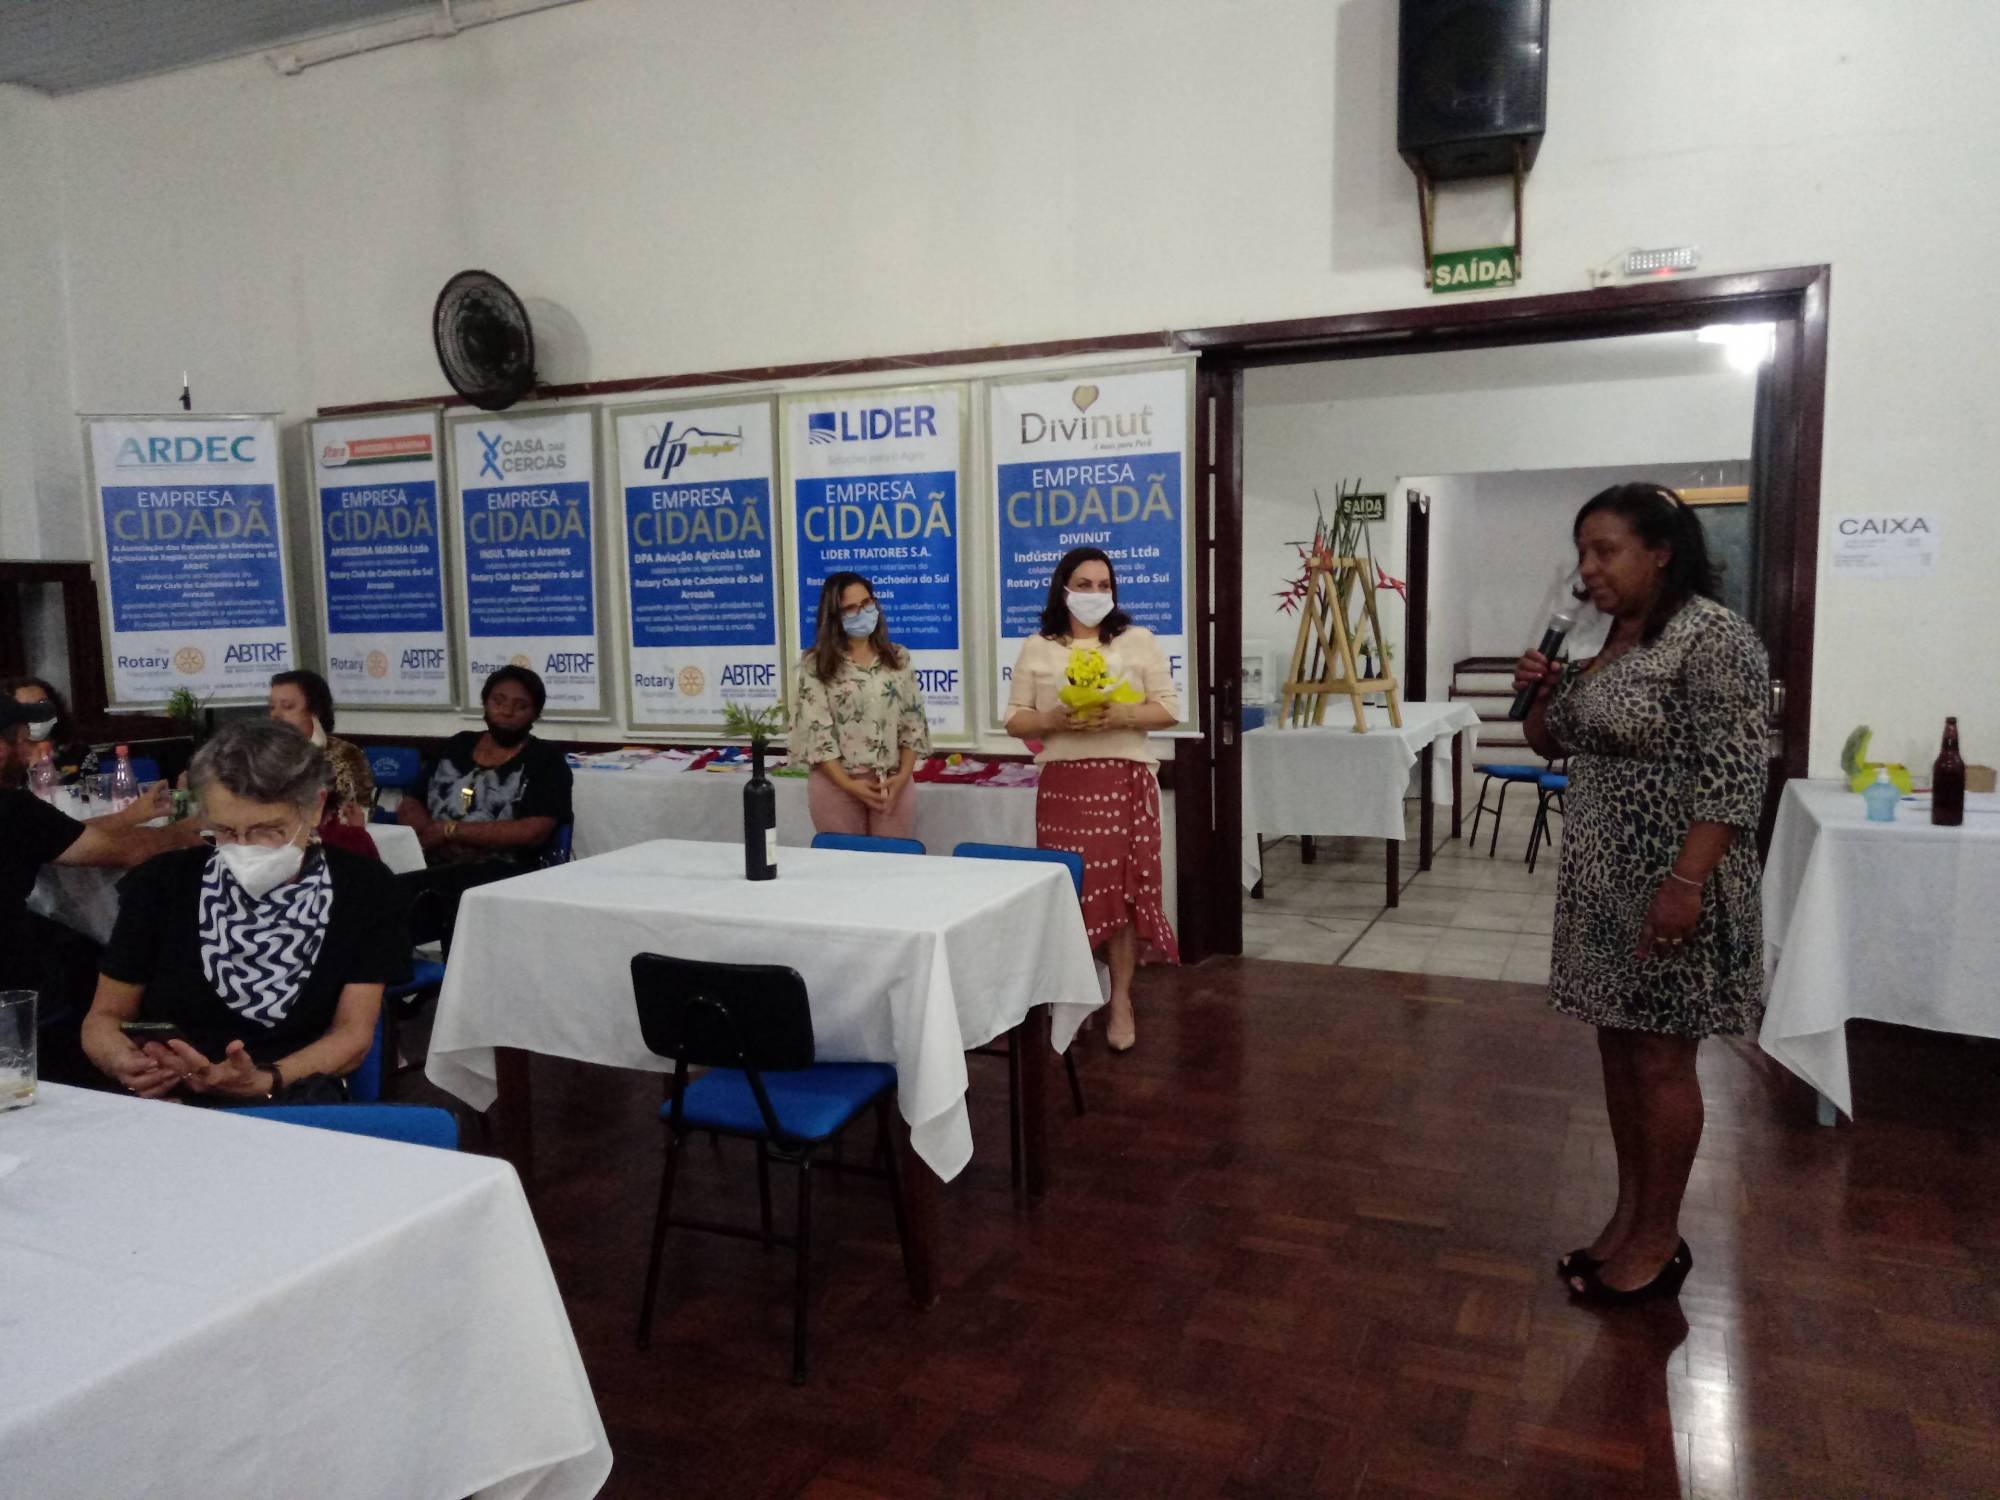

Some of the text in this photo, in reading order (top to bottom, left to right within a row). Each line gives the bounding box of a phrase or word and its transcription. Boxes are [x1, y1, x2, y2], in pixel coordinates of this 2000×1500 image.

[1435, 259, 1513, 287] SAÍDA
[841, 404, 938, 442] LIDER
[1020, 404, 1154, 445] Divinut
[115, 435, 256, 464] ARDEC
[501, 438, 545, 456] CASA
[644, 421, 688, 480] dp
[502, 454, 567, 473] CERCAS
[1032, 463, 1135, 488] EMPRESA
[137, 490, 235, 508] EMPRESA
[342, 488, 408, 508] EMPRESA
[488, 490, 560, 510] EMPRESA
[652, 488, 734, 510] EMPRESA
[826, 481, 917, 503] EMPRESA
[1006, 473, 1173, 529] CIDADÃ
[1343, 497, 1383, 514] SAÍDA
[113, 500, 271, 541] CIDADÃ
[327, 498, 433, 541] CIDADÃ
[469, 499, 586, 544] CIDADÃ
[633, 497, 765, 547] CIDADÃ
[804, 491, 951, 543] CIDADÃ
[1839, 518, 1931, 535] CAIXA
[1059, 532, 1111, 545] DIVINUT
[634, 552, 653, 564] DPA
[655, 551, 693, 565] Aviação
[737, 548, 761, 559] Ltda
[820, 546, 931, 560] LIDER TRATORES S.A.
[1015, 550, 1064, 563] Indústri
[1131, 545, 1159, 558] Ltda
[872, 575, 917, 586] Cachoeira
[920, 574, 932, 583] do
[934, 573, 949, 583] Sul
[1006, 578, 1040, 590] Rotary
[1136, 575, 1150, 584] do
[1152, 573, 1169, 583] Sul
[118, 642, 287, 670] Rotary ABTRF
[330, 648, 444, 673] Rotary ABTRF
[544, 653, 594, 673] ABTRF
[635, 664, 776, 690] Rotary ABTRF
